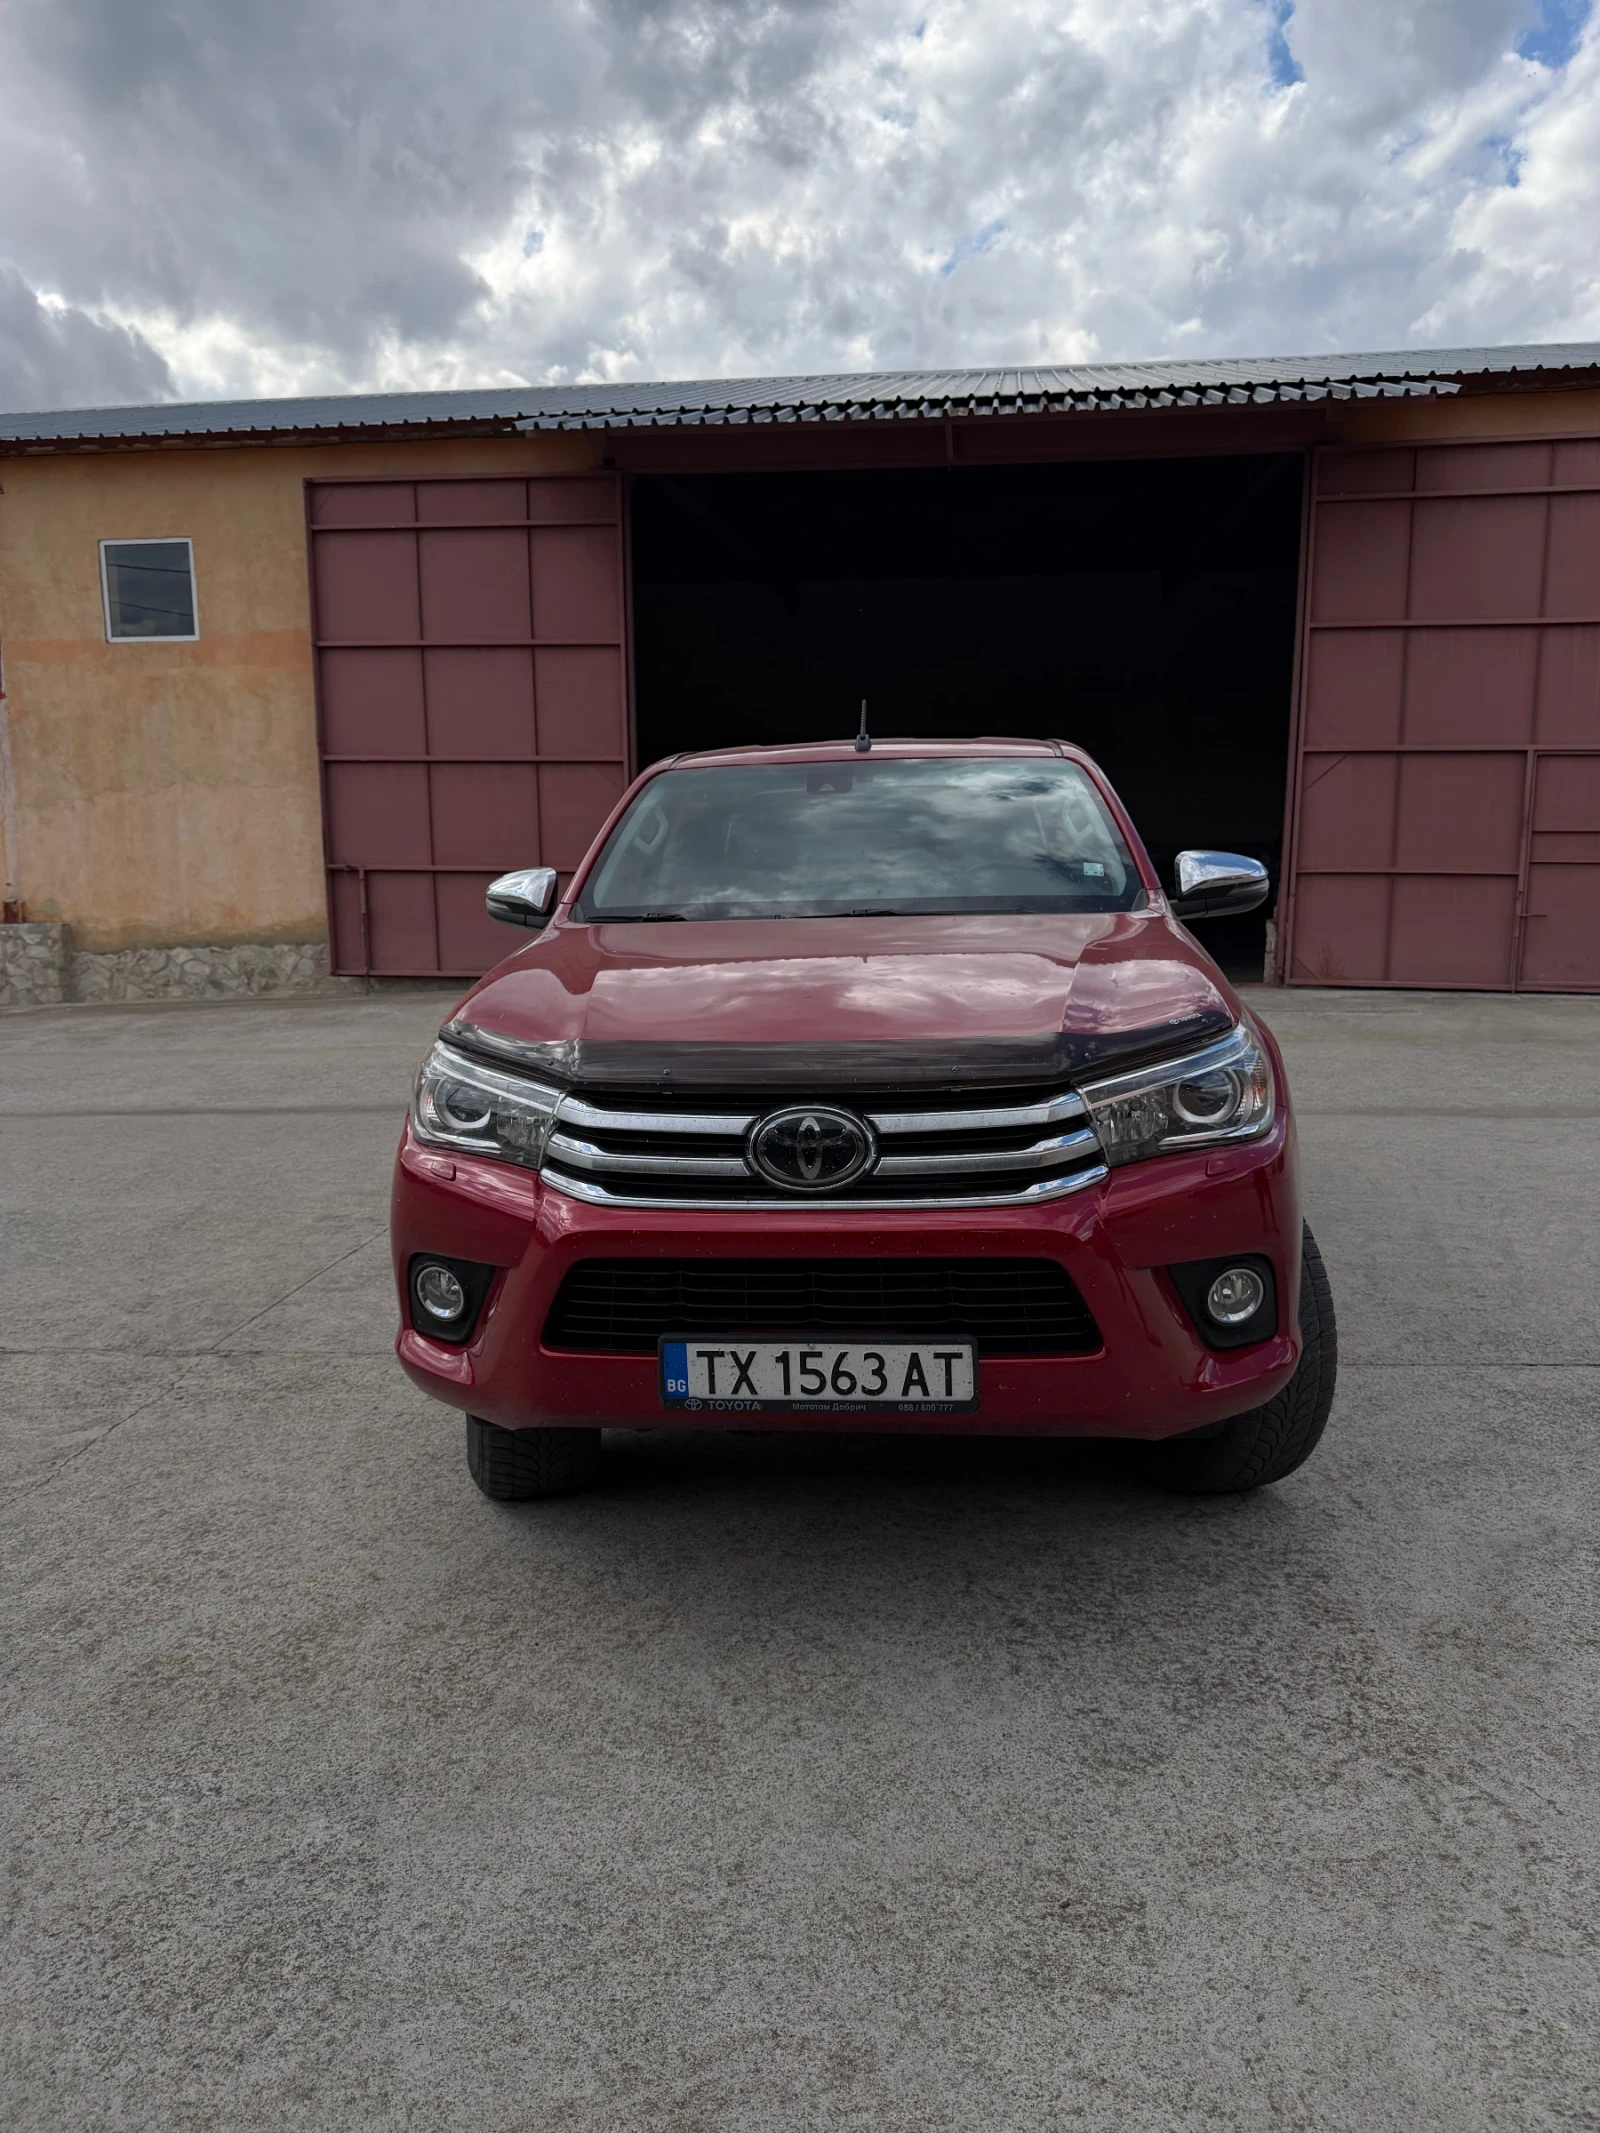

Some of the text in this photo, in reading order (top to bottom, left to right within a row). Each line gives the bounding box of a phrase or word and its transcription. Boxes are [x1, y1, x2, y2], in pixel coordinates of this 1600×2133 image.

[696, 1350, 963, 1397] TX 1563 AT
[667, 1379, 686, 1392] BG
[708, 1400, 761, 1411] TOYOTA
[832, 1402, 866, 1412] Добрич
[898, 1404, 914, 1412] 058
[938, 1404, 954, 1412] 777
